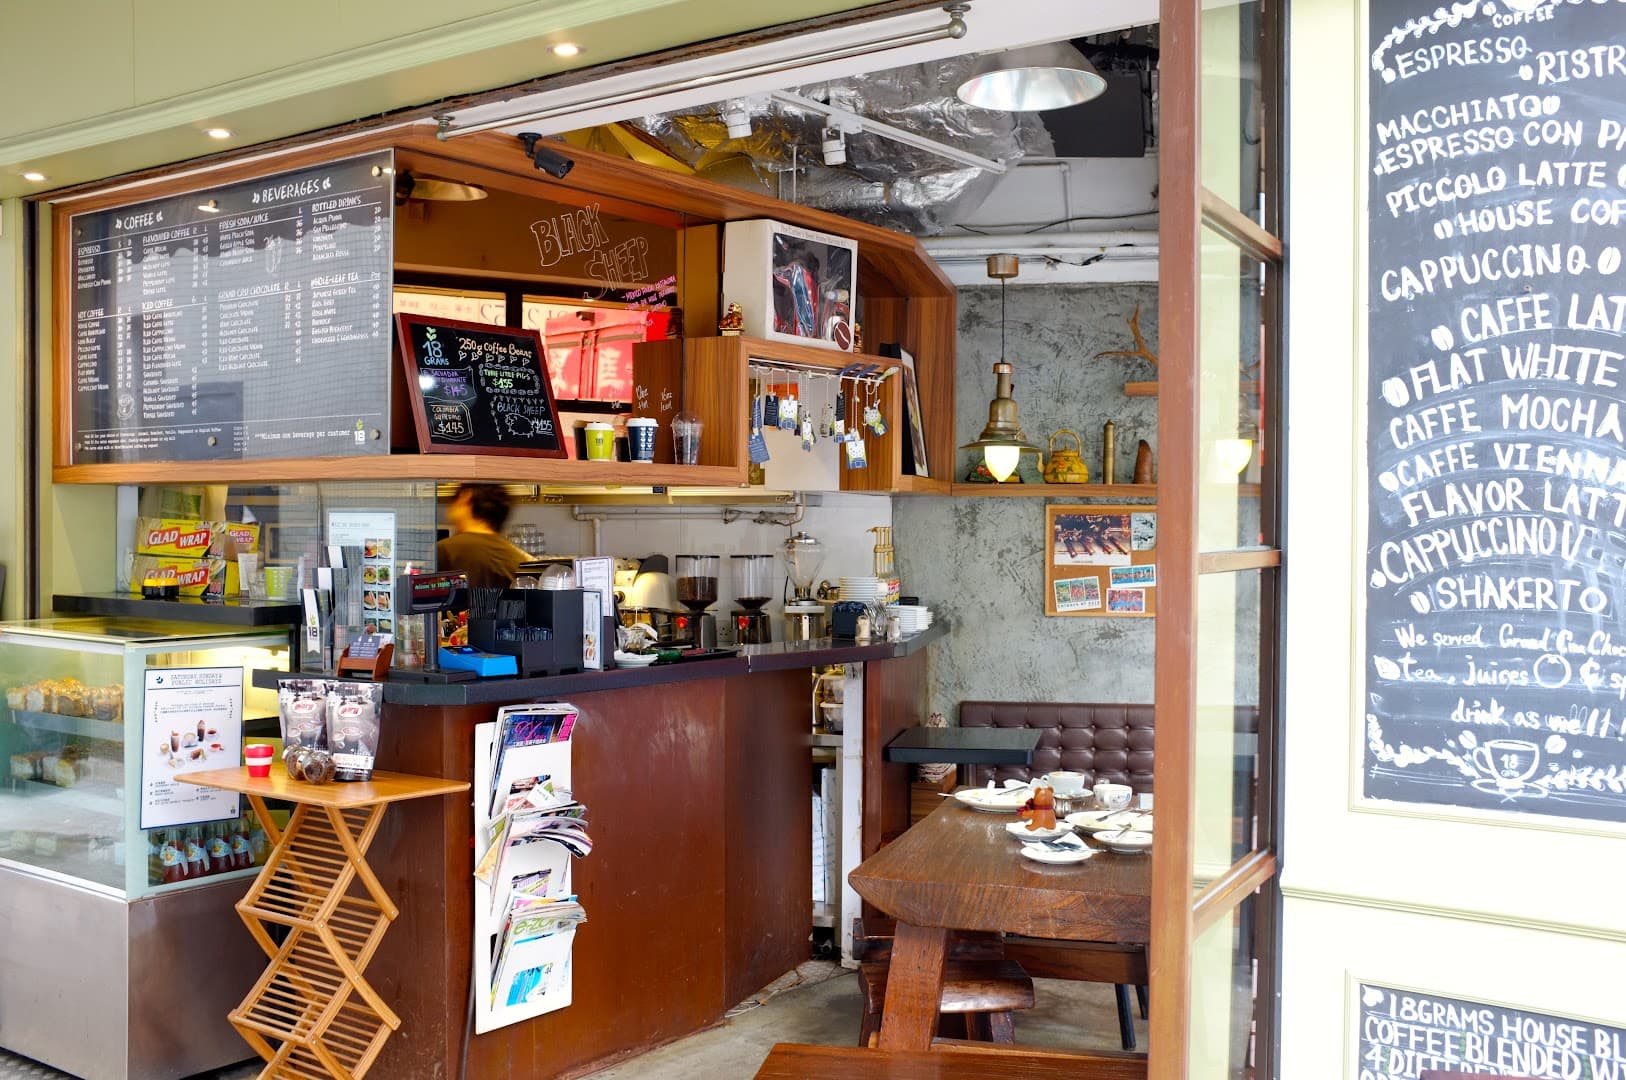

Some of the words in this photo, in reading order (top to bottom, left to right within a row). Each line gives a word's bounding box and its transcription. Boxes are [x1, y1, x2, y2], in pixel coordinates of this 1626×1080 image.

[1492, 5, 1554, 28] COFFEE
[1394, 36, 1532, 80] ESPRESSO
[1376, 94, 1543, 145] MACCHIATO
[1378, 126, 1518, 174] ESPRESSO
[1523, 120, 1582, 147] CON
[262, 178, 320, 202] BEVERAGES
[1386, 166, 1506, 218] PICCOLO
[1519, 161, 1607, 188] LATTE
[312, 199, 336, 212] BOTTLED
[338, 195, 360, 207] DRINKS
[124, 212, 154, 230] COFFEE
[1458, 198, 1553, 236] HOUSE
[170, 227, 189, 238] COFFEE
[530, 203, 609, 266] BLACK
[310, 273, 345, 287] WHOLE-LEAF
[348, 271, 358, 282] TEA
[584, 237, 648, 300] SHEEP
[1381, 244, 1591, 301] CAPPUCCINO
[250, 283, 280, 295] CHOCOLATE
[87, 307, 103, 317] COFFEE
[142, 301, 153, 310] ICED
[154, 299, 173, 308] COFFEE
[1461, 294, 1552, 342] CAFFE
[422, 340, 442, 358] 18
[459, 338, 482, 356] 250g
[484, 342, 507, 354] Coffee
[424, 356, 449, 366] GRAMS
[1410, 348, 1487, 401] FLAT
[1501, 342, 1624, 387] WHITE
[516, 372, 531, 380] PIGS
[497, 402, 520, 413] BLACK
[524, 405, 546, 416] SHEEP
[292, 429, 314, 438] beverage
[316, 429, 325, 437] per
[438, 420, 464, 434] $145
[1390, 398, 1482, 449] CAFFE
[1502, 394, 1624, 442] MOCHA
[354, 430, 365, 441] 18
[1397, 442, 1478, 486] CAFFE
[1402, 478, 1531, 527] FLAVOR
[149, 531, 178, 546] GLAD
[180, 533, 206, 547] WRAP
[1380, 518, 1556, 584] CAPPUCCINO
[178, 571, 205, 585] WRAP
[308, 627, 318, 637] 18
[1394, 624, 1427, 648] We
[1433, 624, 1483, 646] served
[1499, 623, 1551, 652] Grand
[1463, 655, 1528, 686] juices
[1451, 697, 1510, 727] drink
[1514, 711, 1540, 729] as
[1500, 754, 1518, 770] 18
[1390, 993, 1495, 1036] 18GRAMS
[1502, 1014, 1588, 1054] HOUSE
[1364, 1016, 1461, 1060] COFFEE
[1466, 1032, 1582, 1080] BLENDED
[1365, 1044, 1389, 1070] 4
